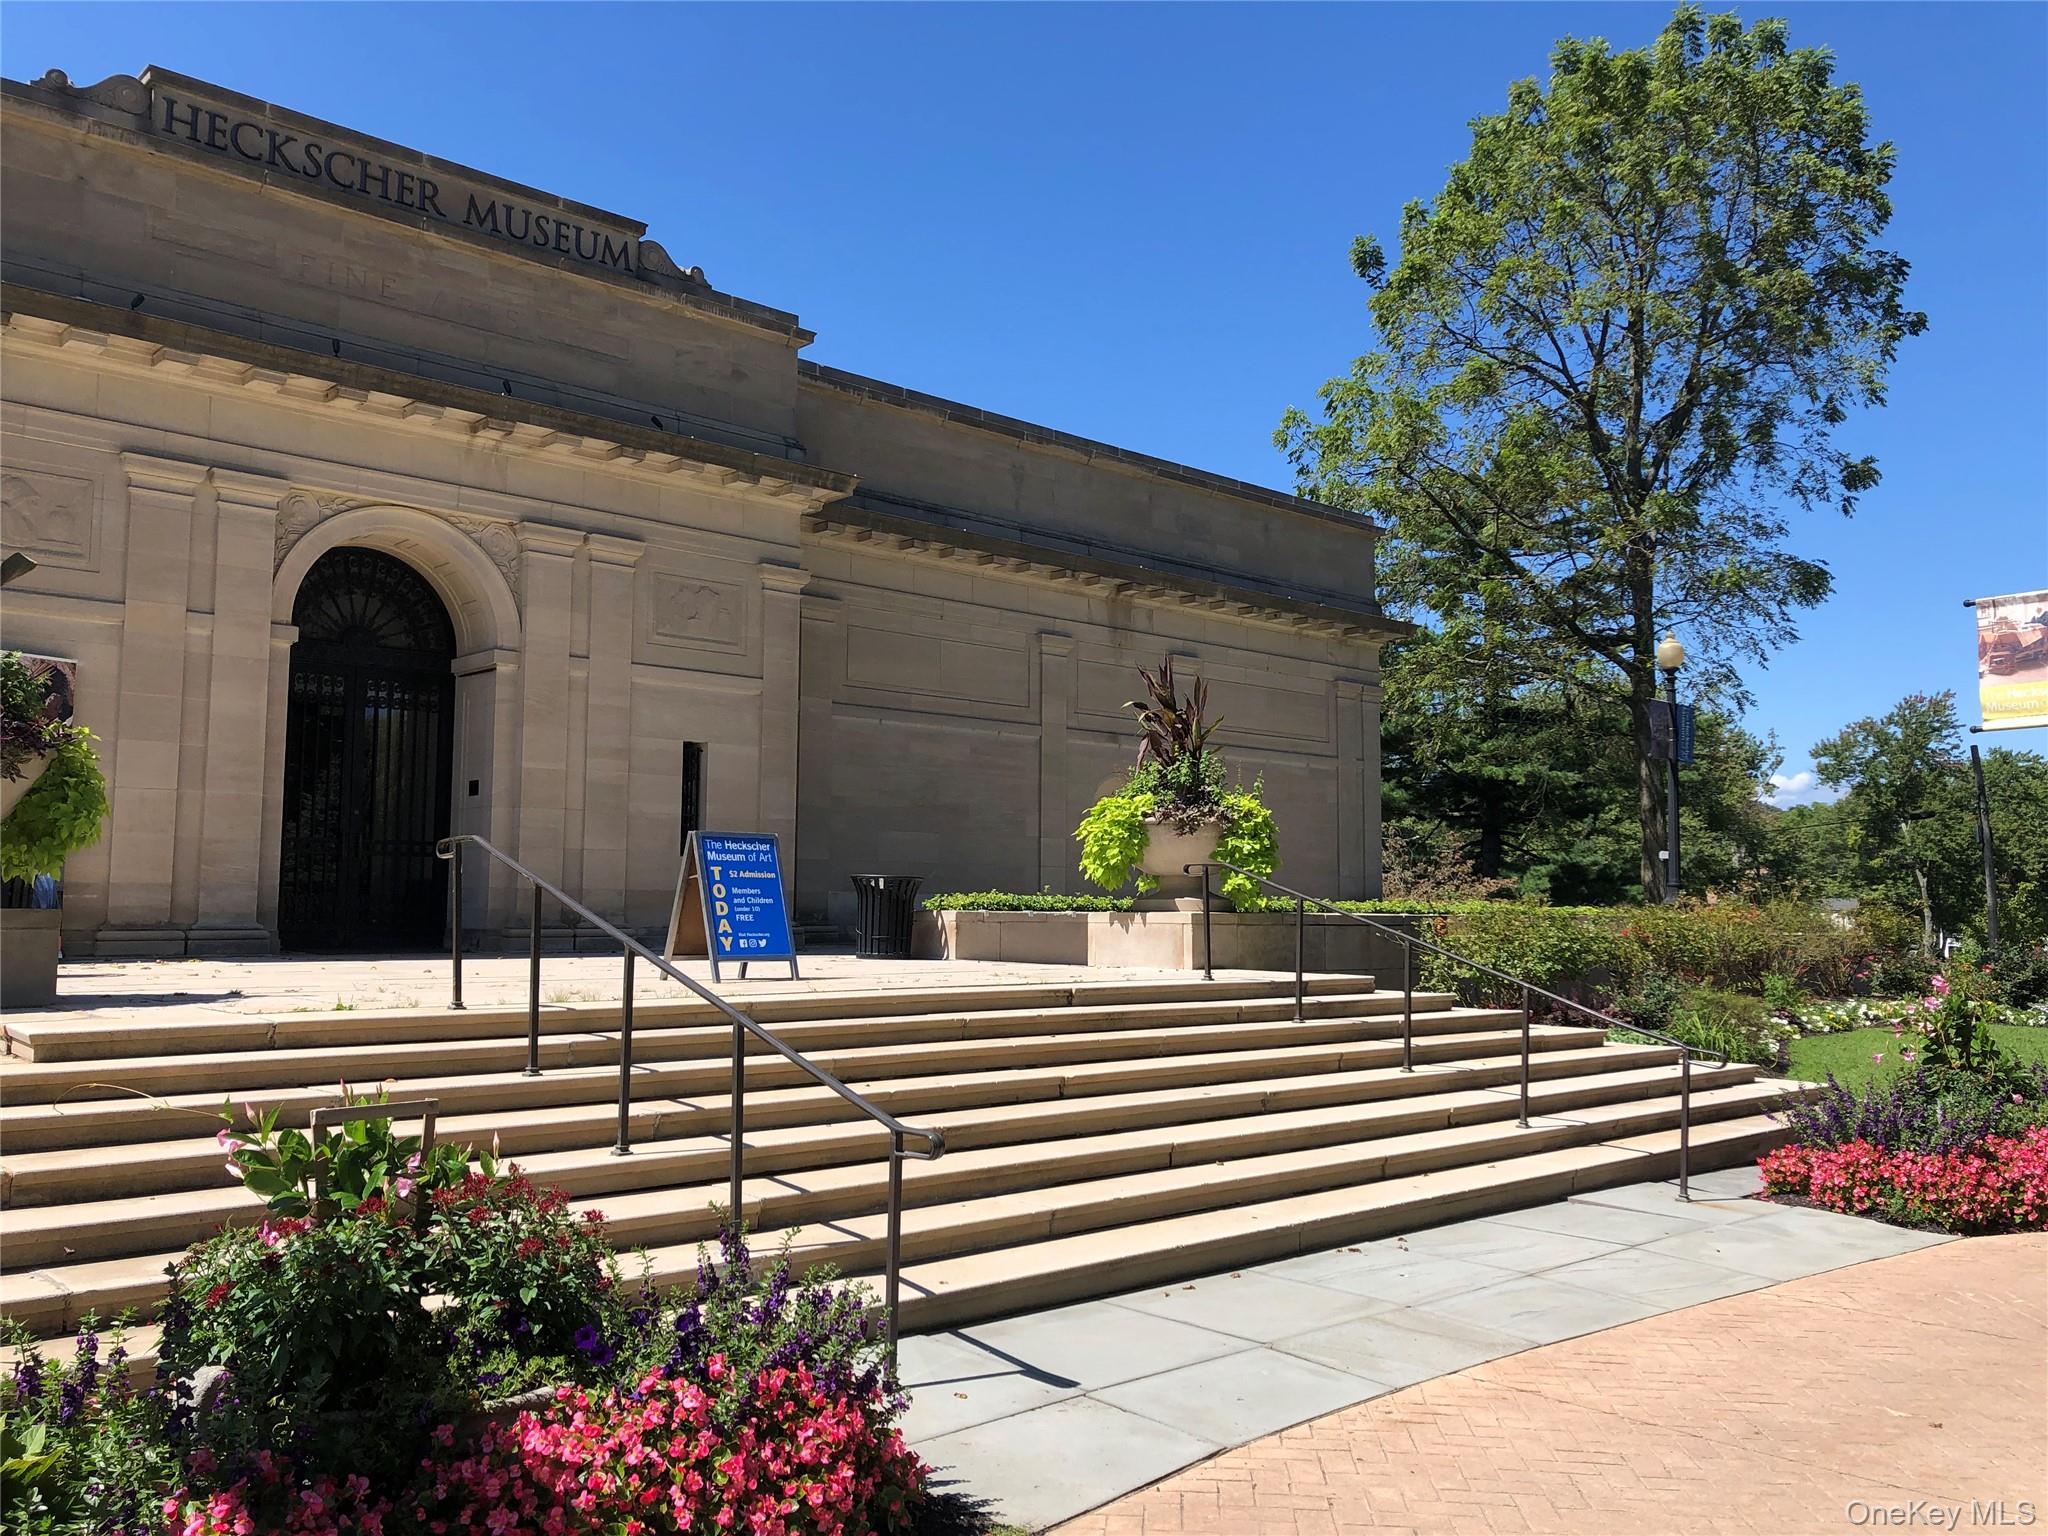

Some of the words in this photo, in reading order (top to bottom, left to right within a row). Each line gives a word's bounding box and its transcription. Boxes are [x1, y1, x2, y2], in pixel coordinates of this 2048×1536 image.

[161, 96, 447, 218] HECKSCHER
[462, 193, 634, 273] MUSEUM
[705, 839, 722, 850] The
[724, 840, 771, 851] Heckscher
[707, 851, 746, 862] Museum
[748, 852, 757, 862] of
[759, 852, 773, 862] Art
[739, 870, 776, 879] Admission
[732, 887, 761, 895] Members
[733, 896, 745, 904] and
[746, 896, 774, 904] Children
[710, 866, 733, 952] TODAY
[736, 914, 755, 922] FREE
